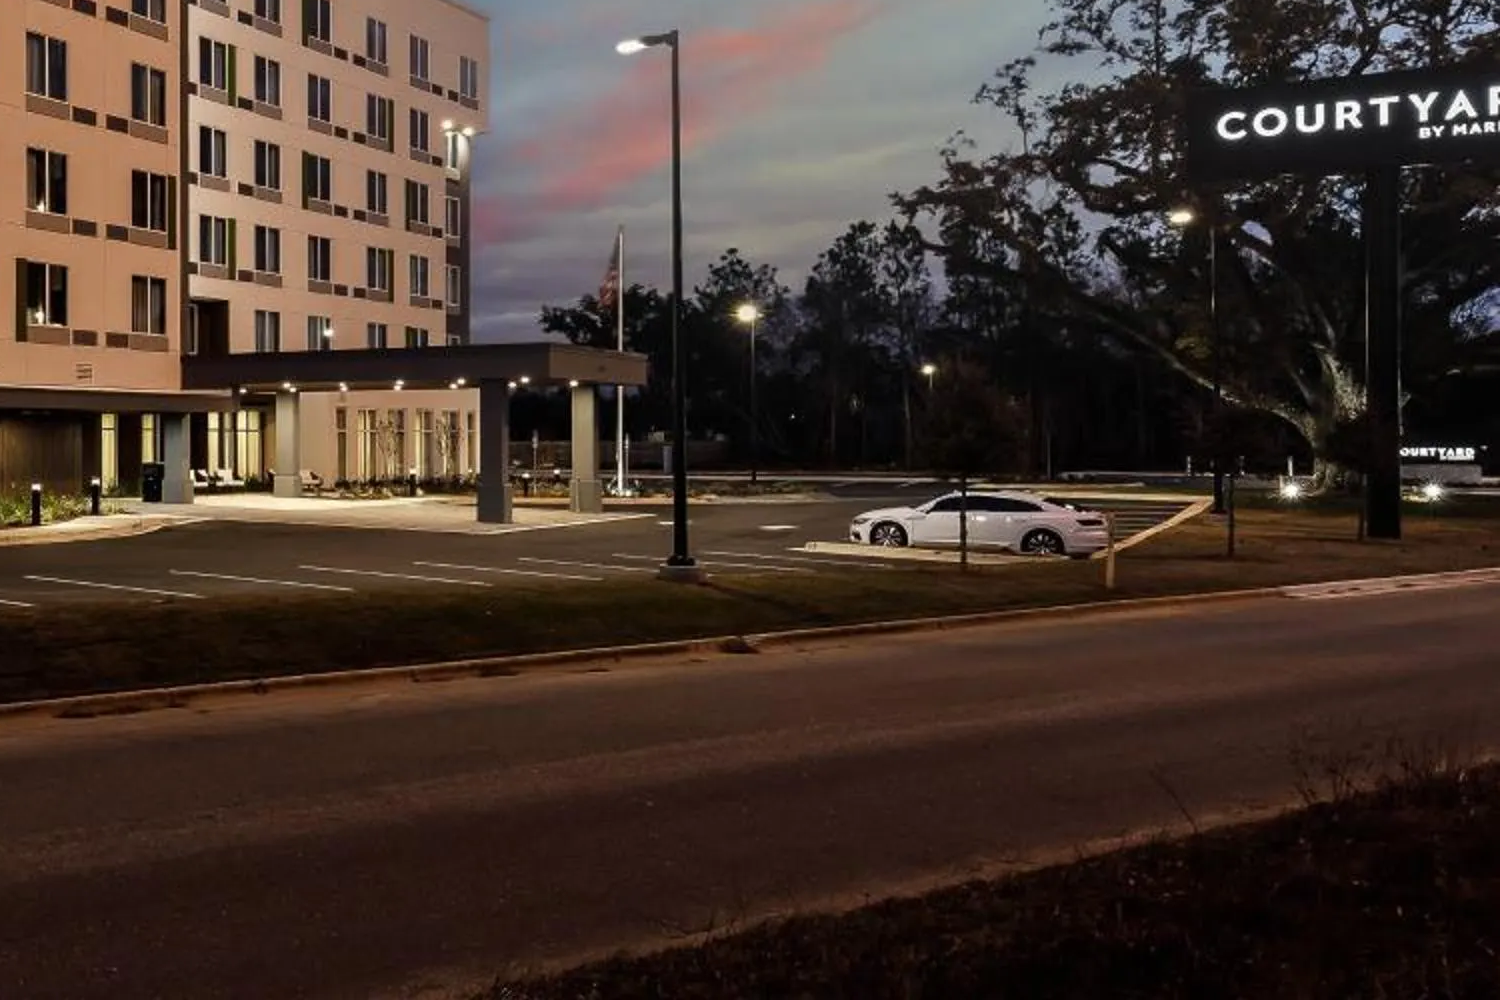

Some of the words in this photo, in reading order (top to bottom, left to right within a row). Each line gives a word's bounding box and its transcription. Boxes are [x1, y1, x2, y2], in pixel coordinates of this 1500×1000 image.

[1418, 125, 1445, 139] BY
[1452, 121, 1500, 136] MAR
[1399, 447, 1475, 458] OURTYARD
